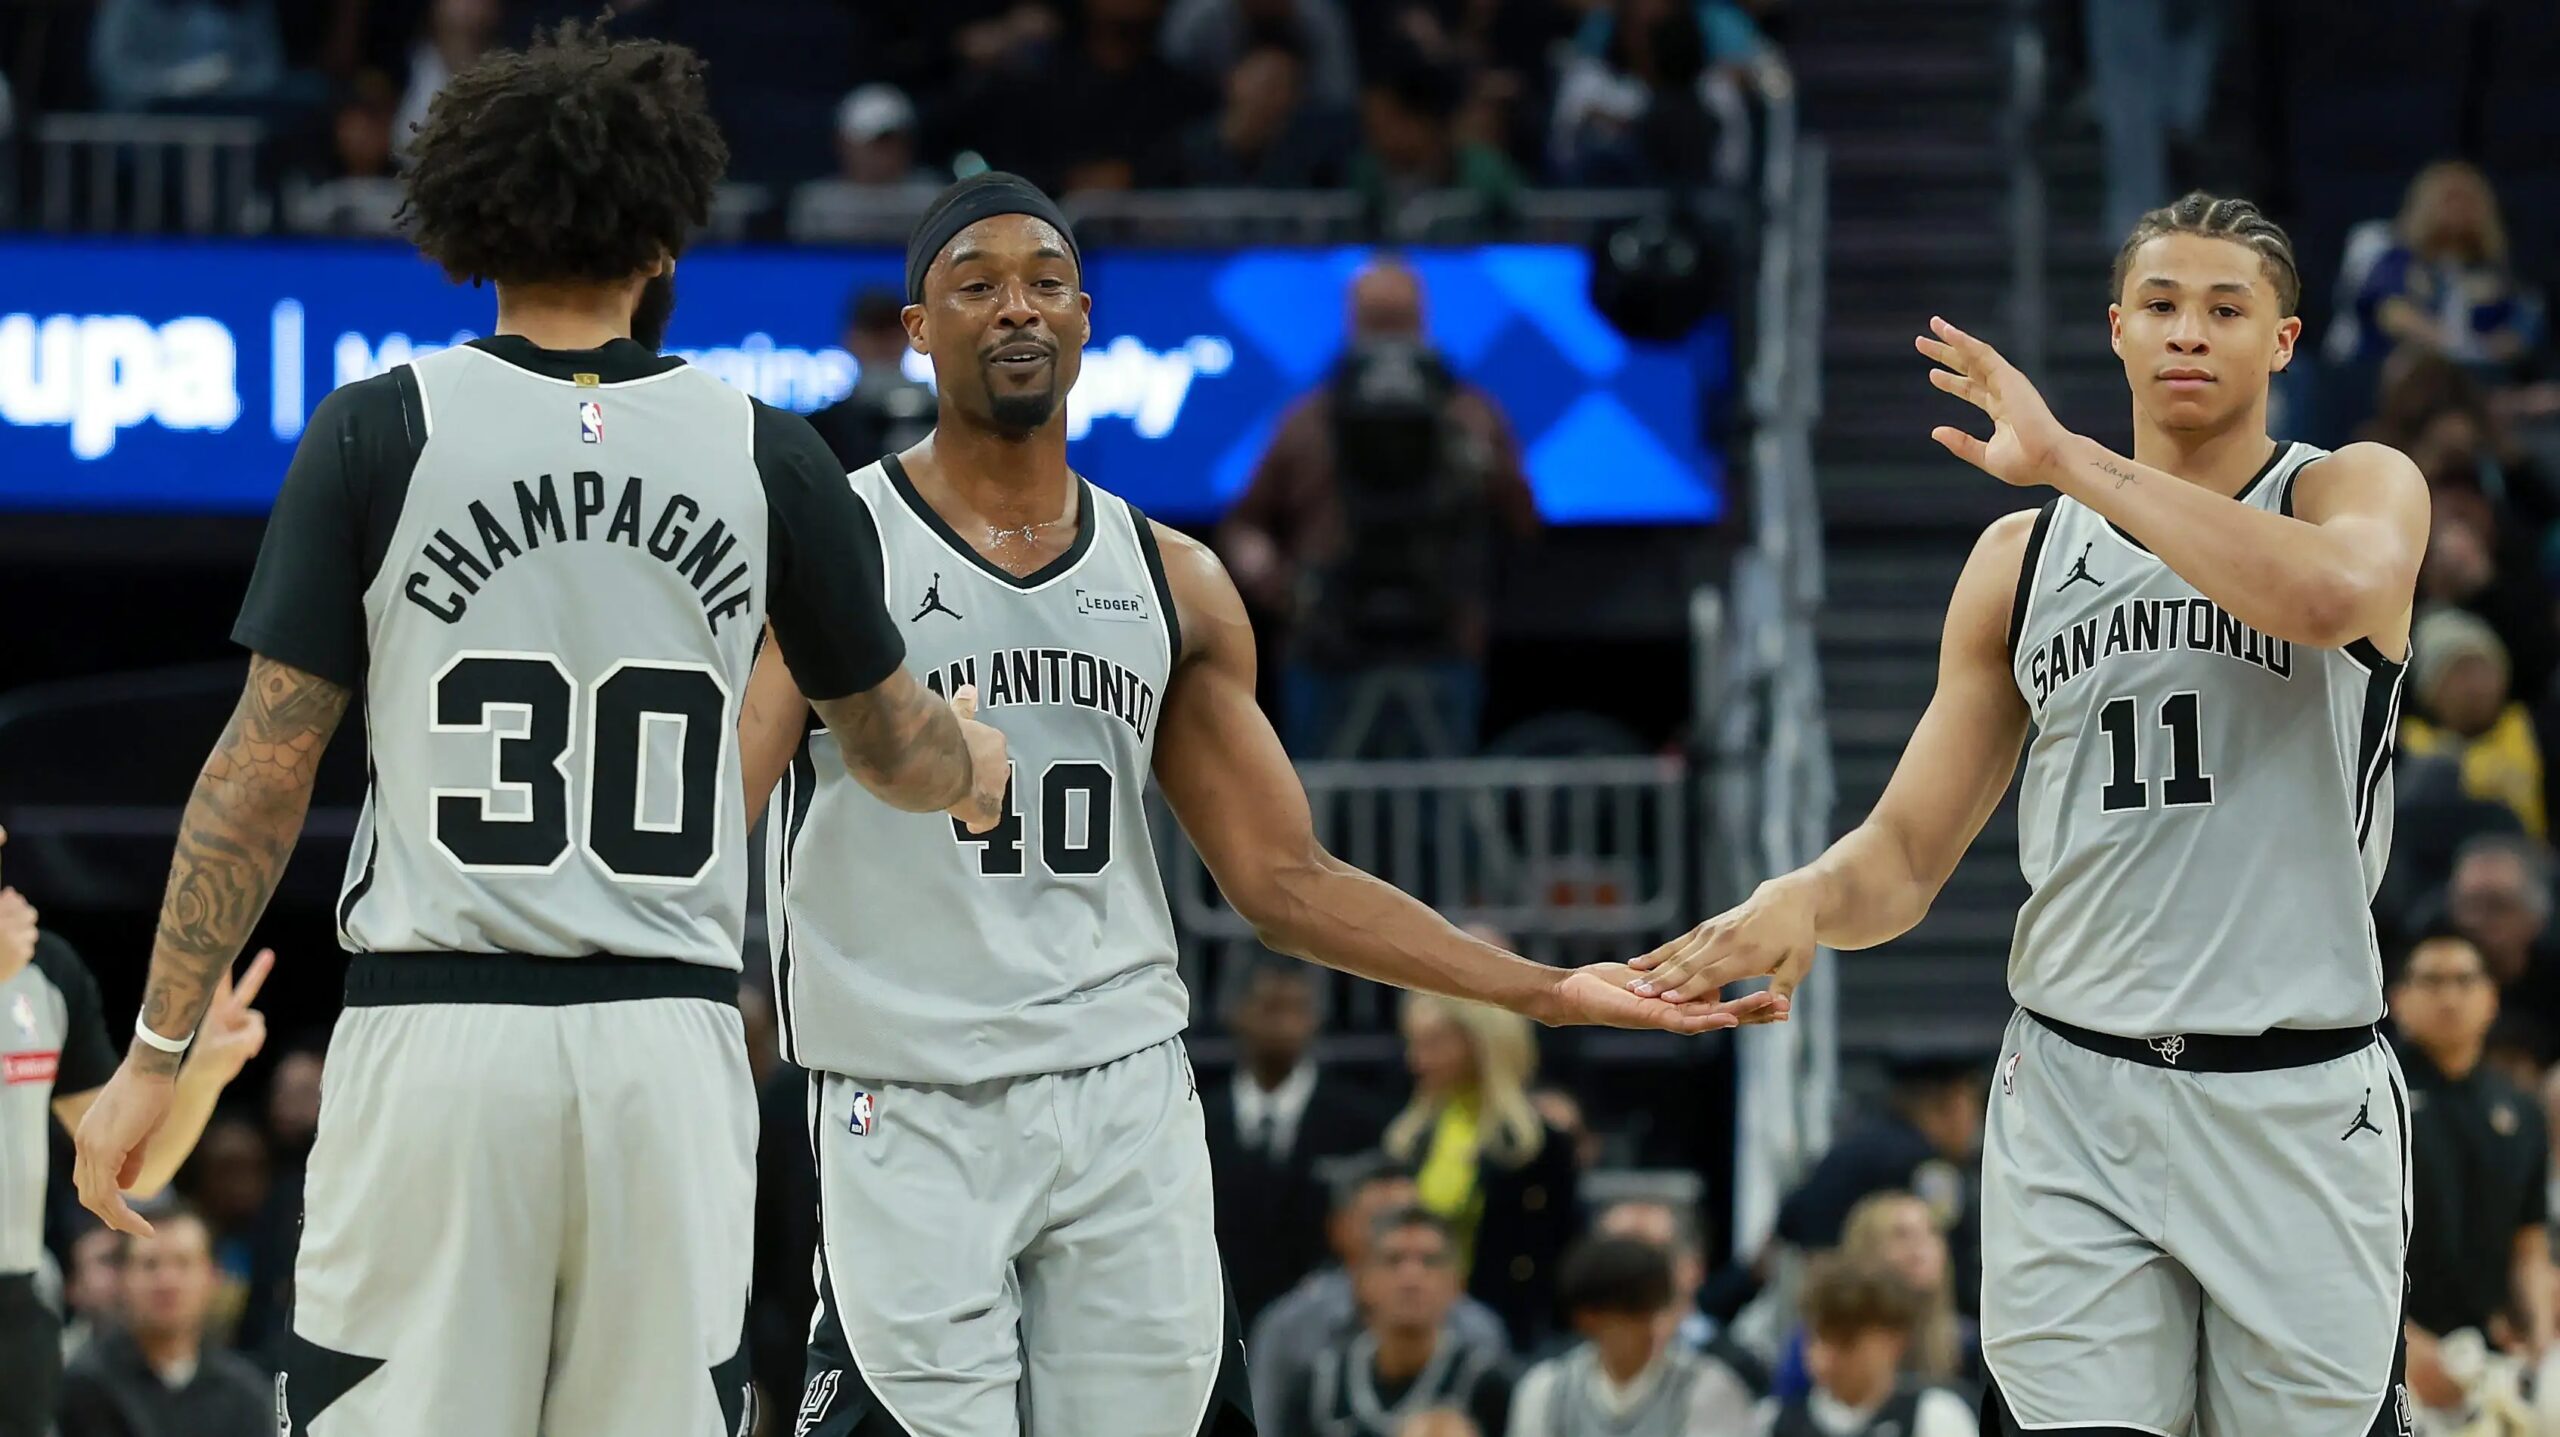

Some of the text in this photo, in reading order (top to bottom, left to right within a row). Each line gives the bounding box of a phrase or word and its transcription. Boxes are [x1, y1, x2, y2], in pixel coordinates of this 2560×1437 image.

[405, 471, 751, 636] CHAMPAGNIE
[1086, 597, 1139, 612] LEDGER
[926, 647, 1154, 748] AN ANTONIO
[2031, 596, 2293, 711] SAN ANTONIO
[429, 650, 733, 886] 30
[2097, 690, 2215, 814] 11
